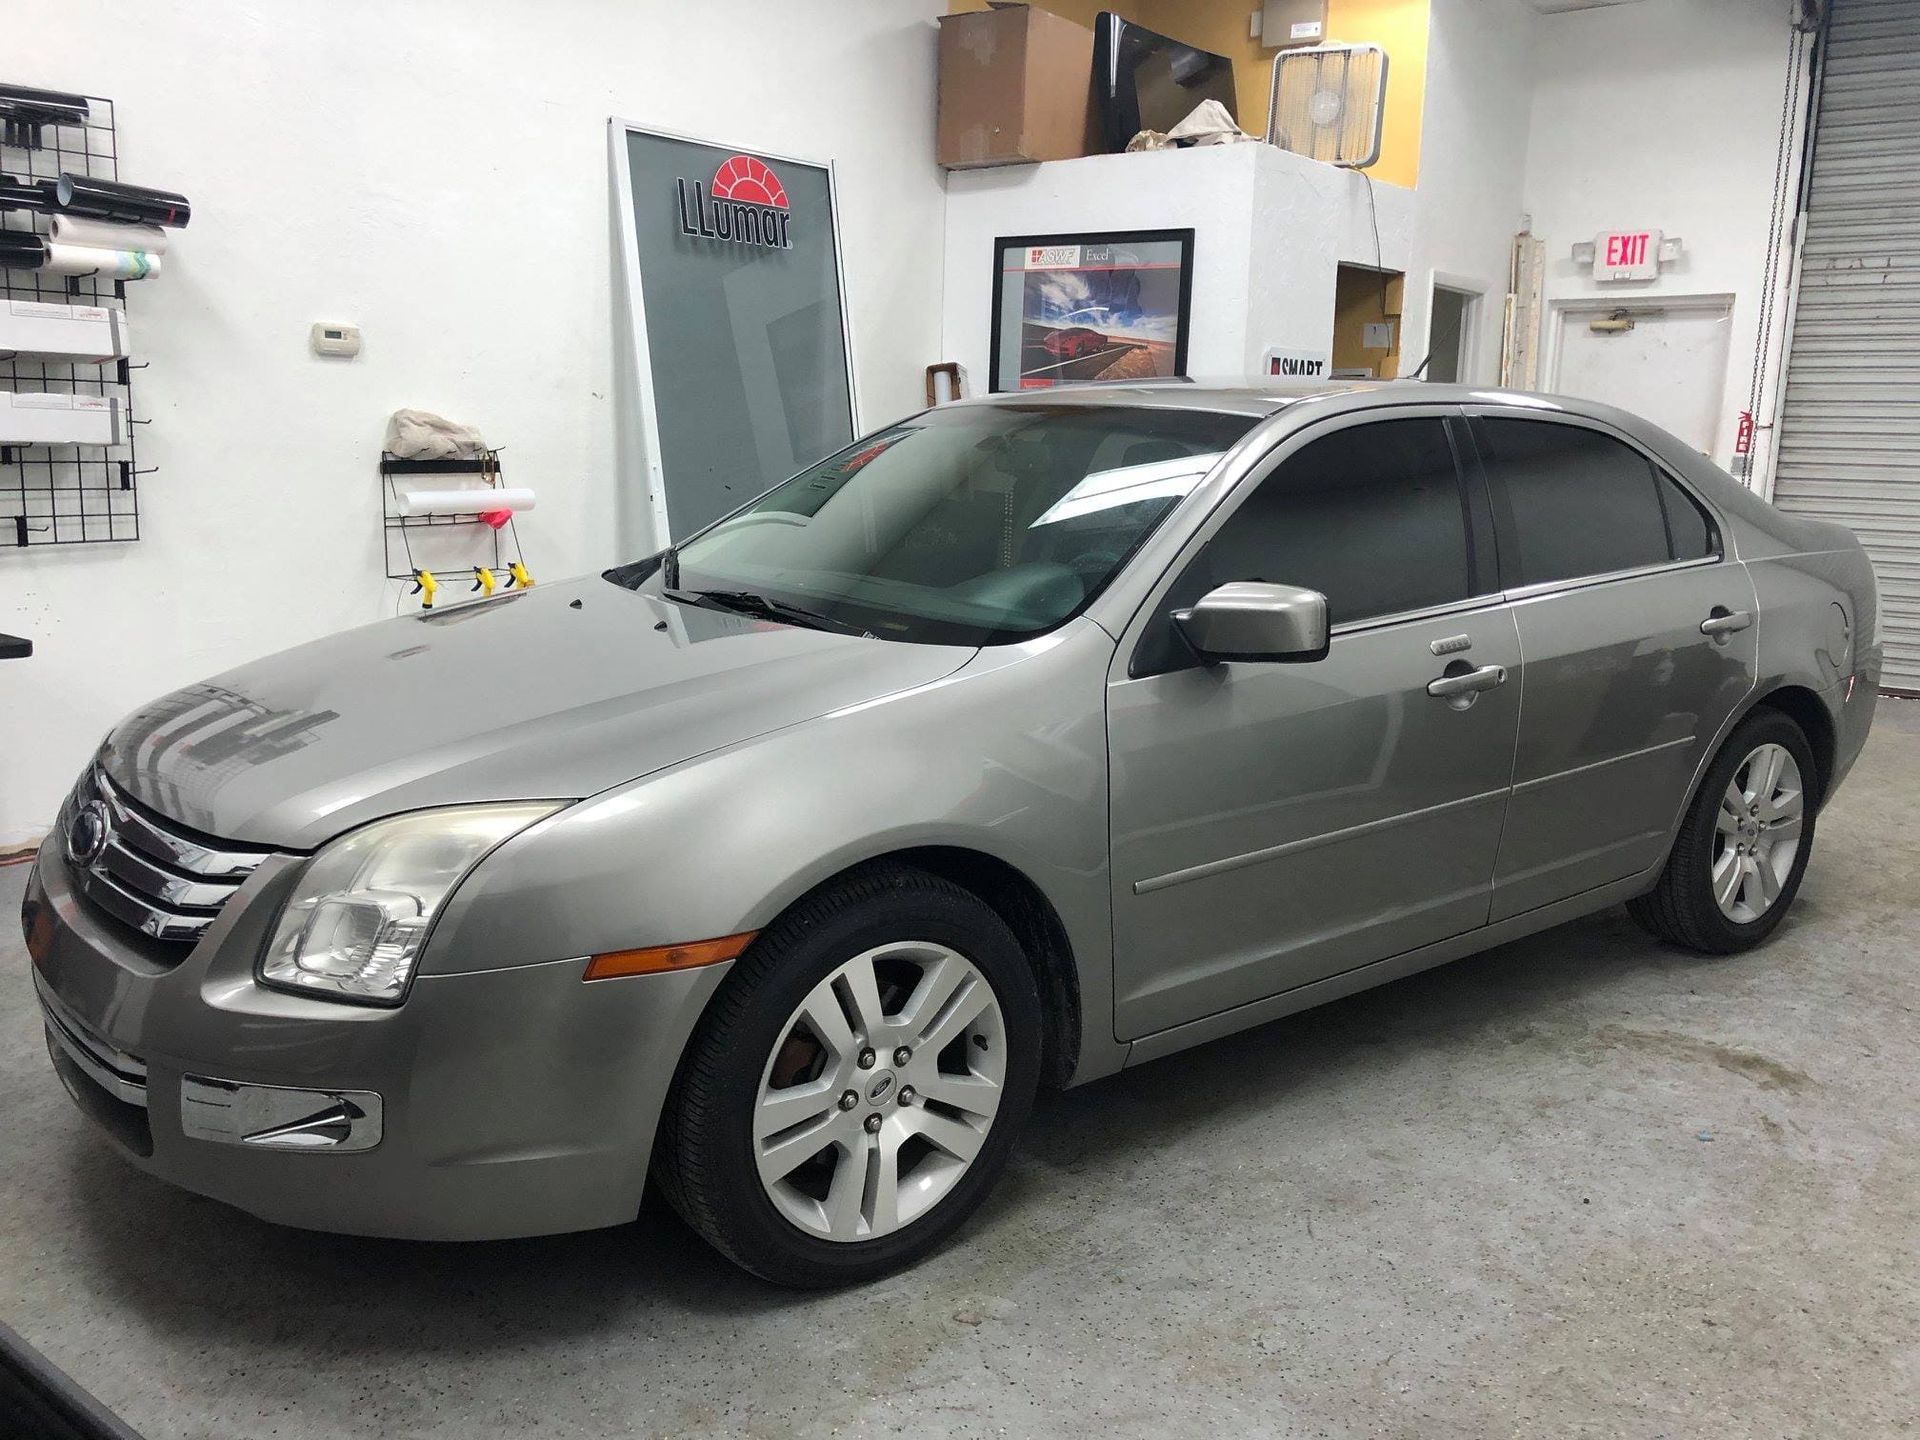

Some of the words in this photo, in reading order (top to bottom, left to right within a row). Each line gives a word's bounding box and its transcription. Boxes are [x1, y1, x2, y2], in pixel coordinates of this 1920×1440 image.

[1086, 247, 1109, 262] Excel
[1606, 234, 1649, 266] EXIT
[1738, 421, 1750, 451] FIRE
